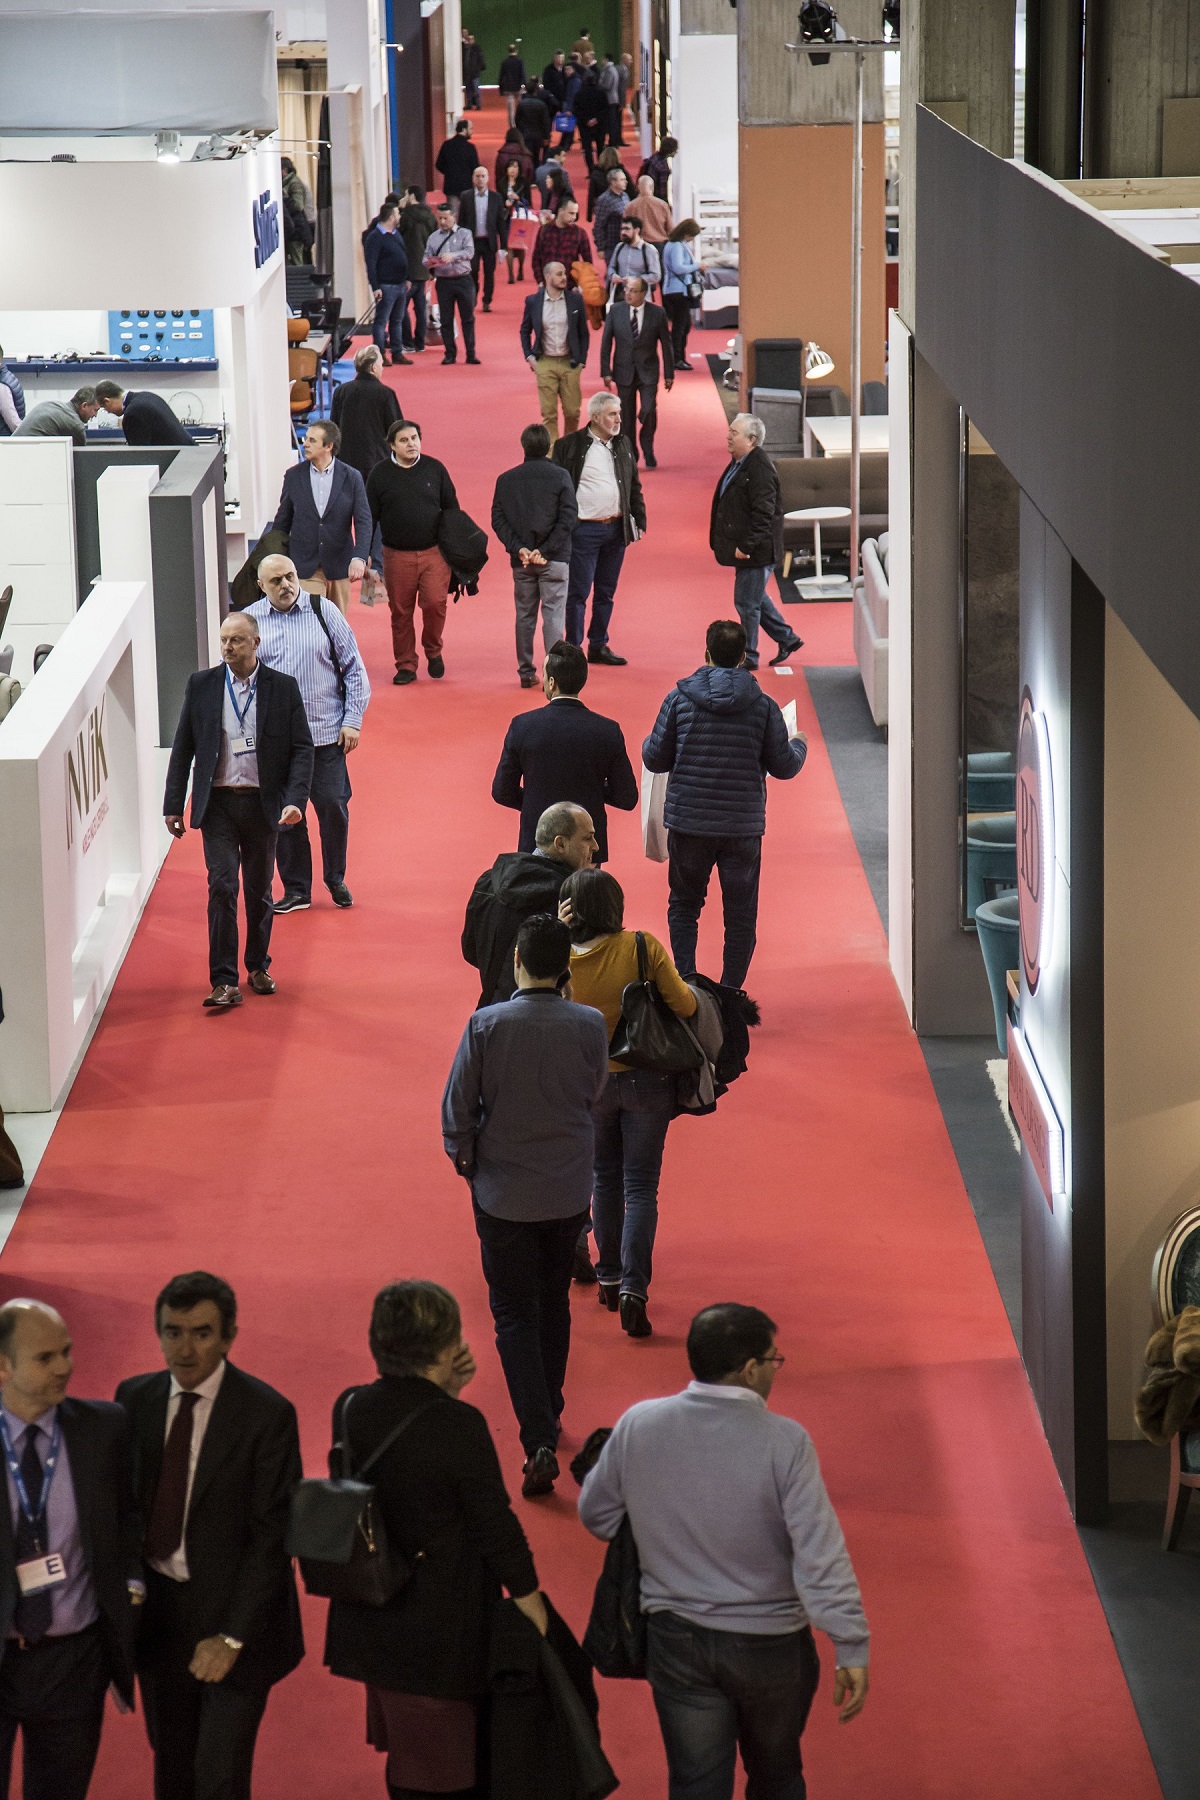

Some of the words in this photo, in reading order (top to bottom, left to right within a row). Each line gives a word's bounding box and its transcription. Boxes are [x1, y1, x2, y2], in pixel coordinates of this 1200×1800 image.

[245, 737, 254, 747] E
[1020, 776, 1040, 903] RD
[45, 1557, 61, 1575] E
